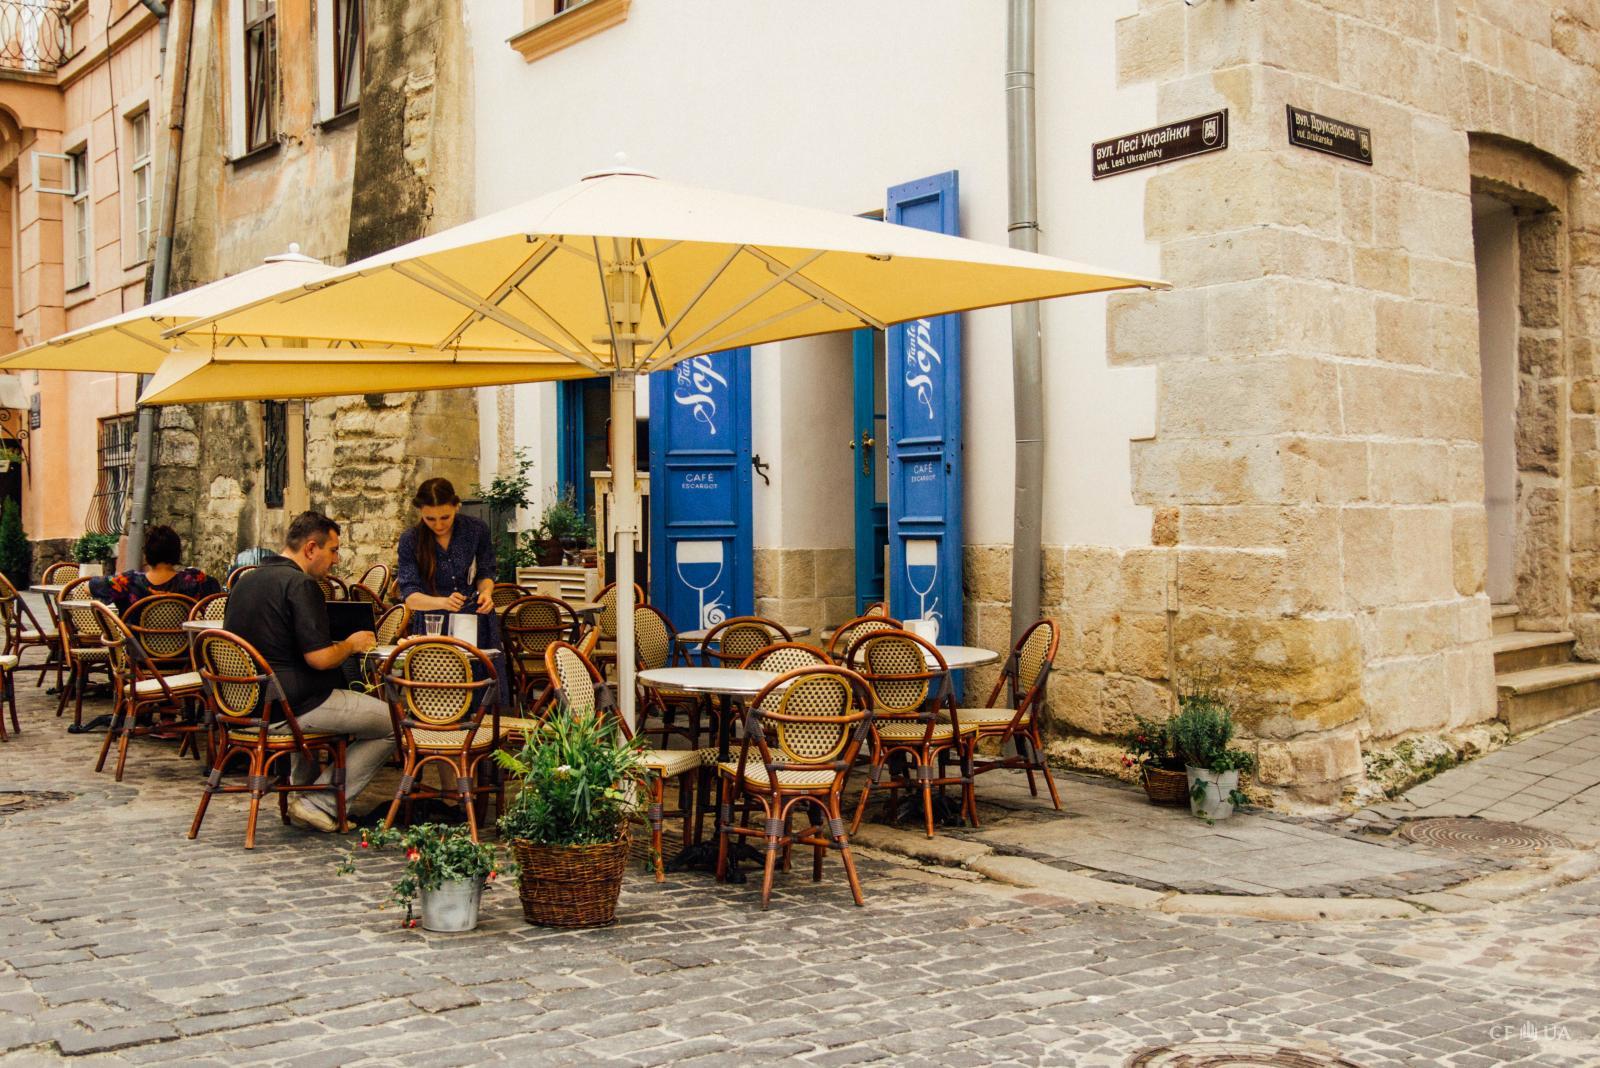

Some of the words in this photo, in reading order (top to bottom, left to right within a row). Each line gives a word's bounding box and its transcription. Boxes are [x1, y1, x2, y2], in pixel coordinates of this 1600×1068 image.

[1295, 113, 1310, 127] вул.
[1310, 114, 1355, 140] Друкарська
[1296, 129, 1306, 138] vul.
[1306, 131, 1333, 146] Drukarska
[1096, 145, 1114, 160] вул.
[1116, 136, 1138, 154] Лесі
[1141, 125, 1190, 148] Українки
[1097, 161, 1110, 171] vul.
[1111, 157, 1126, 168] Lesi
[1126, 148, 1162, 165] Ukrayinky
[677, 359, 691, 386] Tan
[673, 353, 728, 435] Sop
[685, 472, 714, 482] CAFÉ
[913, 461, 933, 474] CAFÉ
